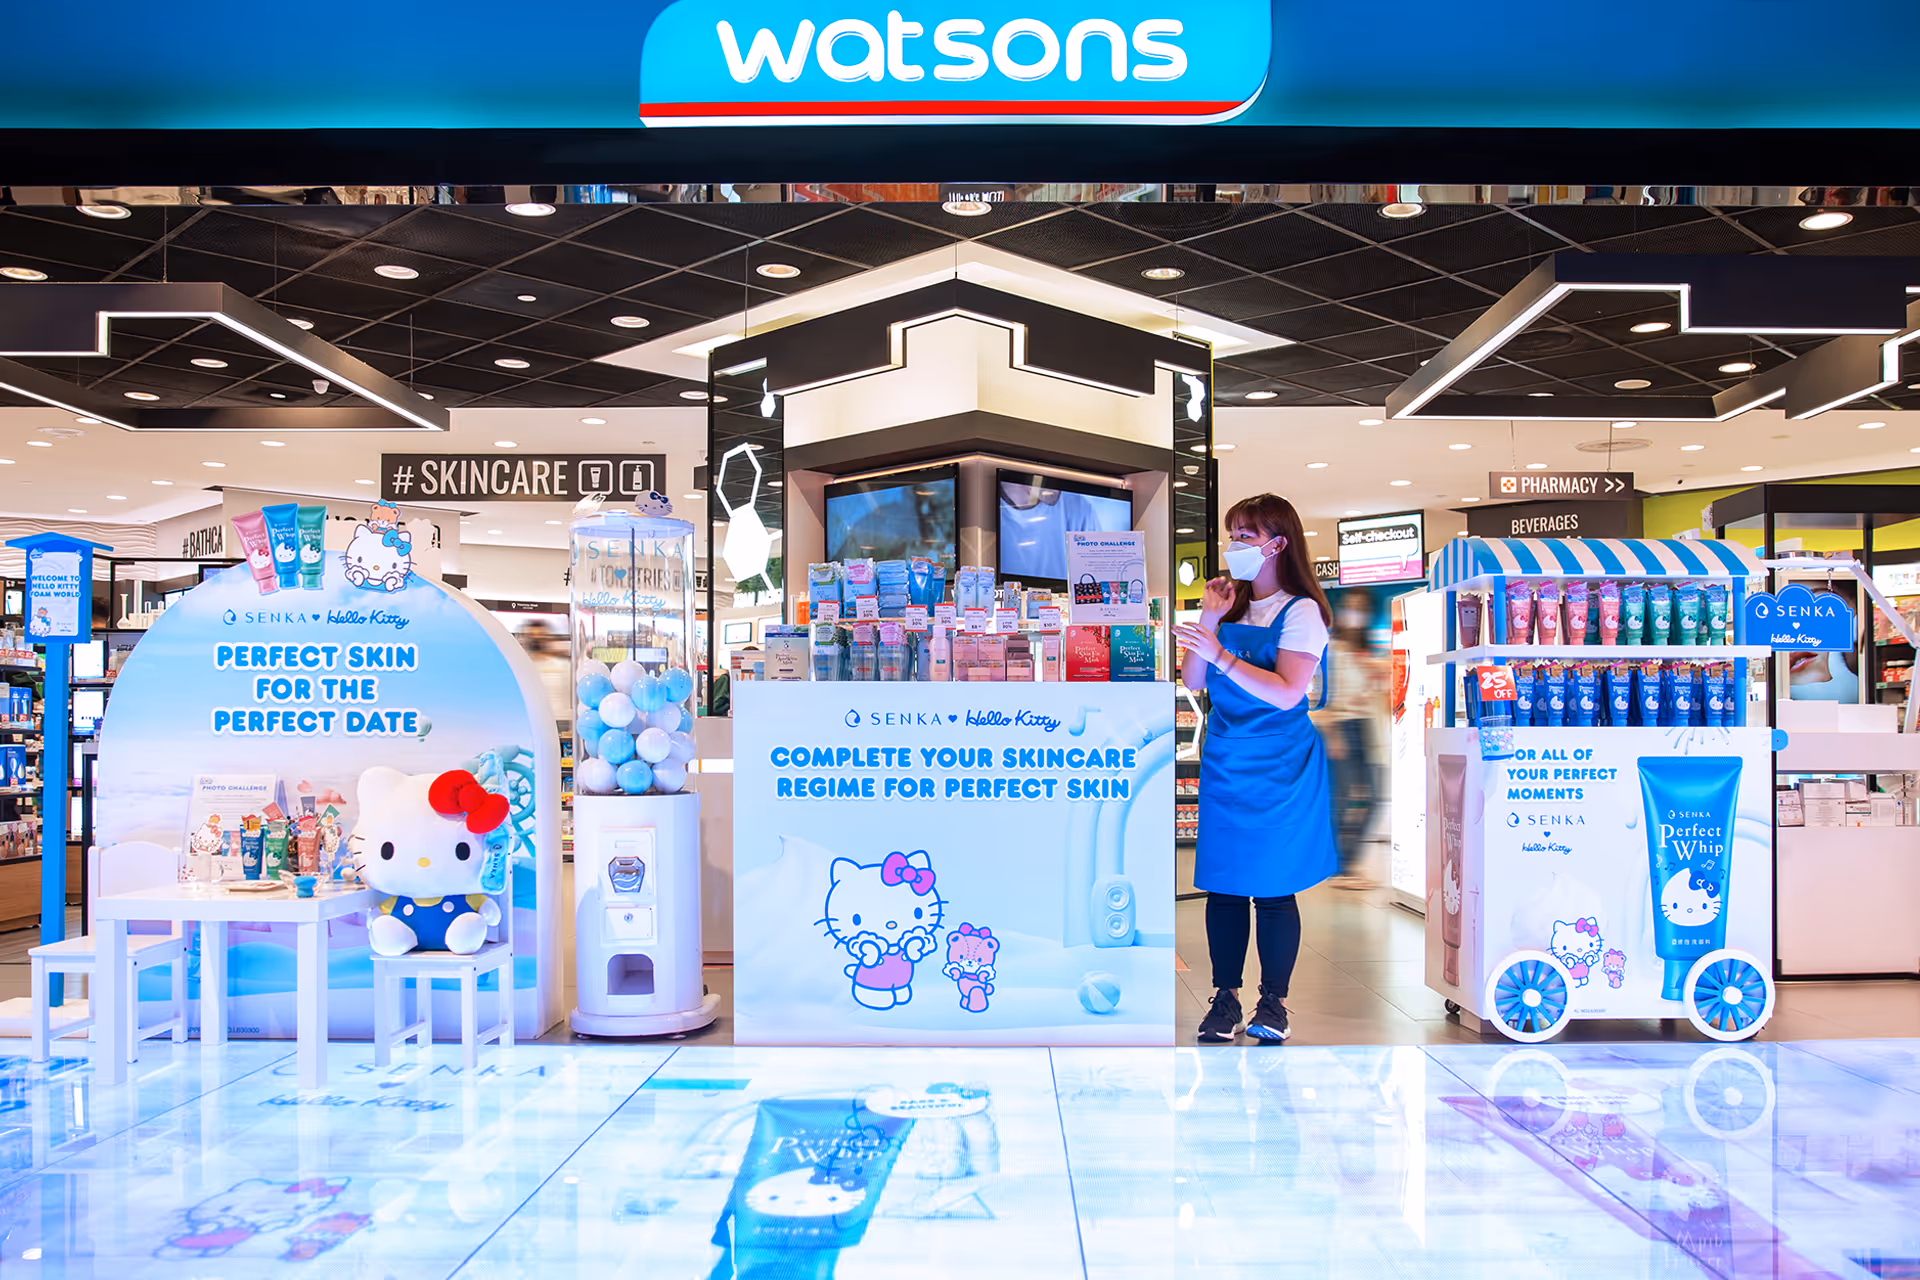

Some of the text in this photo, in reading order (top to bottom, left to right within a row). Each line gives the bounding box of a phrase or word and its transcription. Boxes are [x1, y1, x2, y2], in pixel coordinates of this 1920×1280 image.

[716, 10, 1188, 83] watsons
[420, 460, 568, 495] SKINCARE
[1521, 477, 1599, 493] PHARMACY
[1511, 514, 1579, 535] BEVERAGES
[1342, 527, 1415, 545] Self-checkout
[588, 540, 683, 560] SENKA
[245, 610, 410, 630] SENKA Hello Kitty
[1776, 605, 1836, 618] SENKA
[1770, 633, 1822, 647] Hello Kitty
[217, 645, 415, 668] PERFECT SKIN
[256, 678, 376, 701] FOR THE
[1494, 689, 1513, 699] OFF
[214, 711, 418, 733] PERFECT DATE
[871, 709, 1062, 733] SENKA Hello Kitty
[770, 747, 1136, 769] COMPLETE YOUR SKINCARE
[1510, 749, 1594, 761] OR ALL OF
[1507, 768, 1618, 781] YOUR PERFECT
[777, 777, 1131, 799] REGIME FOR PERFECT SKIN
[1507, 788, 1584, 801] MOMENTS
[1528, 815, 1586, 826] SENKA
[1658, 823, 1721, 848] Perfect
[1522, 842, 1573, 855] Hello Kitty
[1671, 840, 1724, 861] Whip
